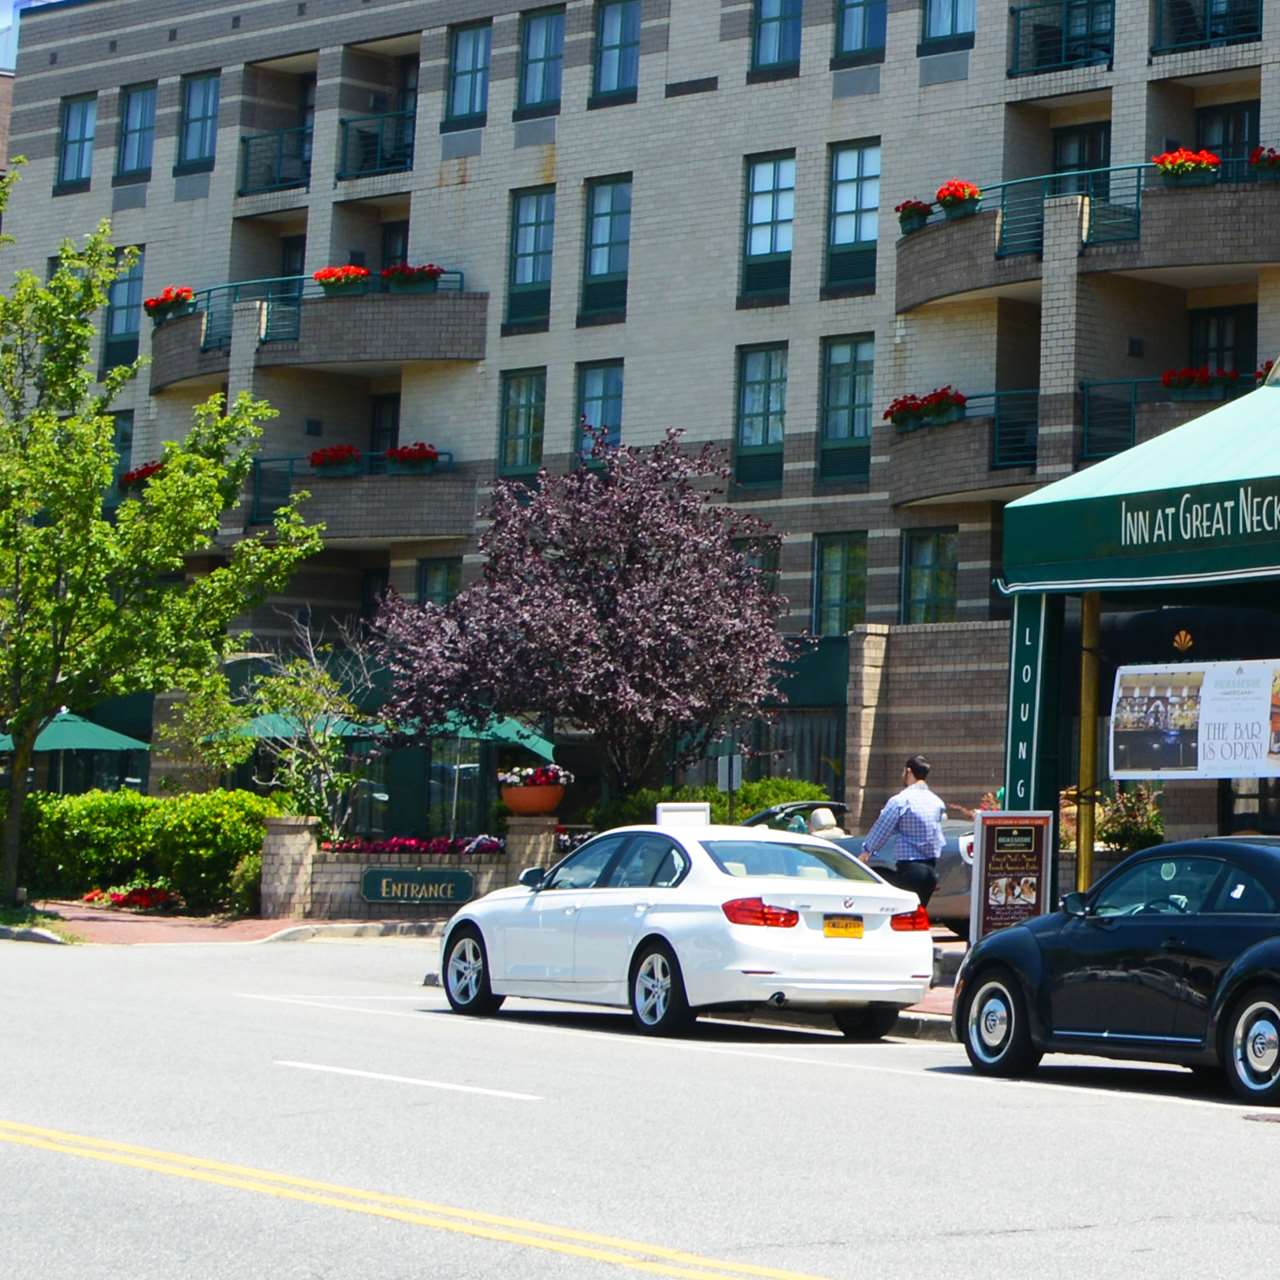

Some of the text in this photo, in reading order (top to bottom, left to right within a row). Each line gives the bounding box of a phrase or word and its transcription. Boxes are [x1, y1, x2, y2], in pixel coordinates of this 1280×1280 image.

[1121, 501, 1149, 546] INN
[1153, 507, 1176, 543] AT
[1179, 493, 1235, 540] GREAT
[1017, 627, 1031, 798] LOUNG
[1204, 721, 1262, 740] THE BAR
[1202, 742, 1263, 760] IS OPEN!
[381, 878, 456, 898] ENTRANCE
